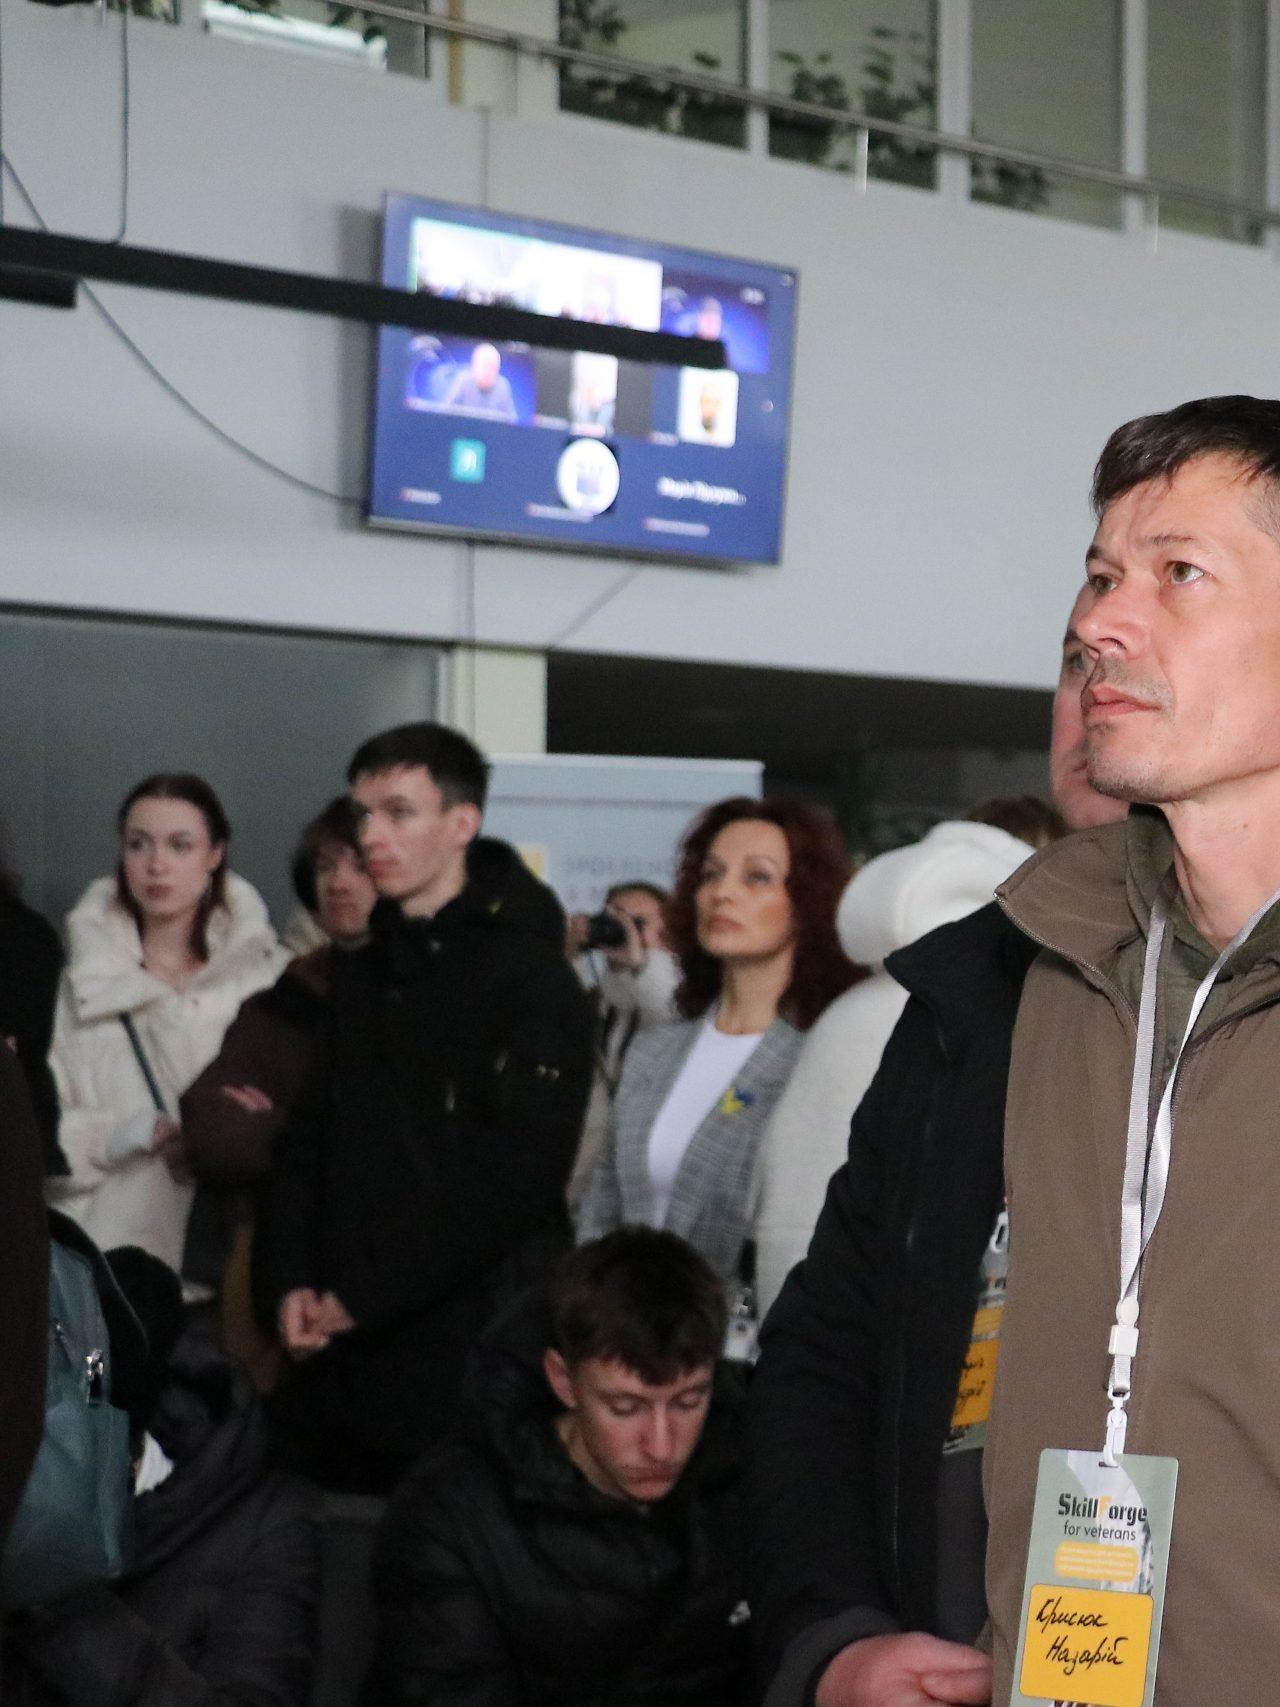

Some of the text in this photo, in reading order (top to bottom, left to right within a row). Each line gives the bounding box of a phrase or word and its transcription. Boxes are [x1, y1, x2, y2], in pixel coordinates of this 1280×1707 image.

[1057, 1492, 1148, 1526] SkillForge
[1063, 1520, 1136, 1541] for veterans
